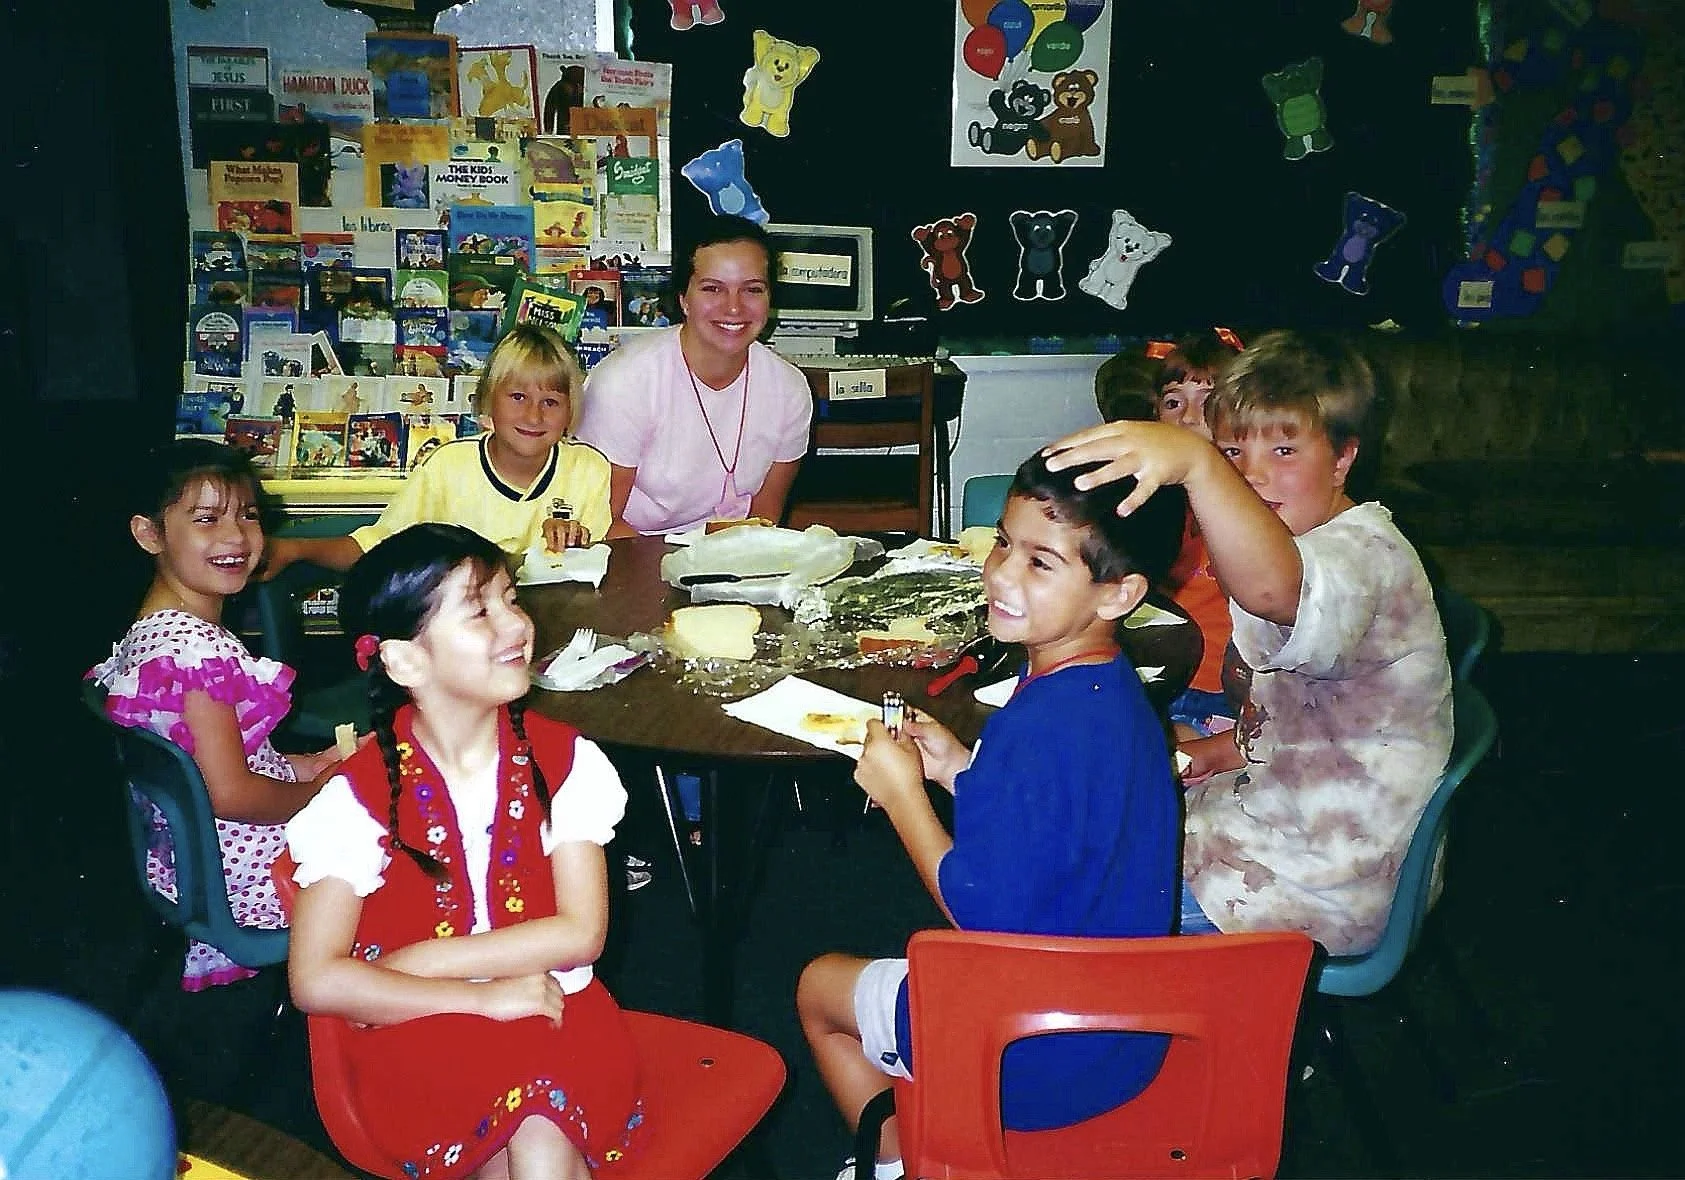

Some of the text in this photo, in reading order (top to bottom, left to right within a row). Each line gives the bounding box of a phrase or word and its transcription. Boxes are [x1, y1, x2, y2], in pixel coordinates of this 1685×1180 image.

[1046, 41, 1071, 50] verde
[211, 72, 247, 83] JESUS
[283, 74, 371, 96] HAMILTON DUCK
[1001, 123, 1029, 132] negro
[225, 164, 282, 174] What Makes
[448, 165, 469, 175] THE
[435, 174, 509, 185] MONEY BOOK
[791, 265, 848, 281] computadora
[533, 307, 555, 321] MISS
[835, 380, 873, 396] la silla
